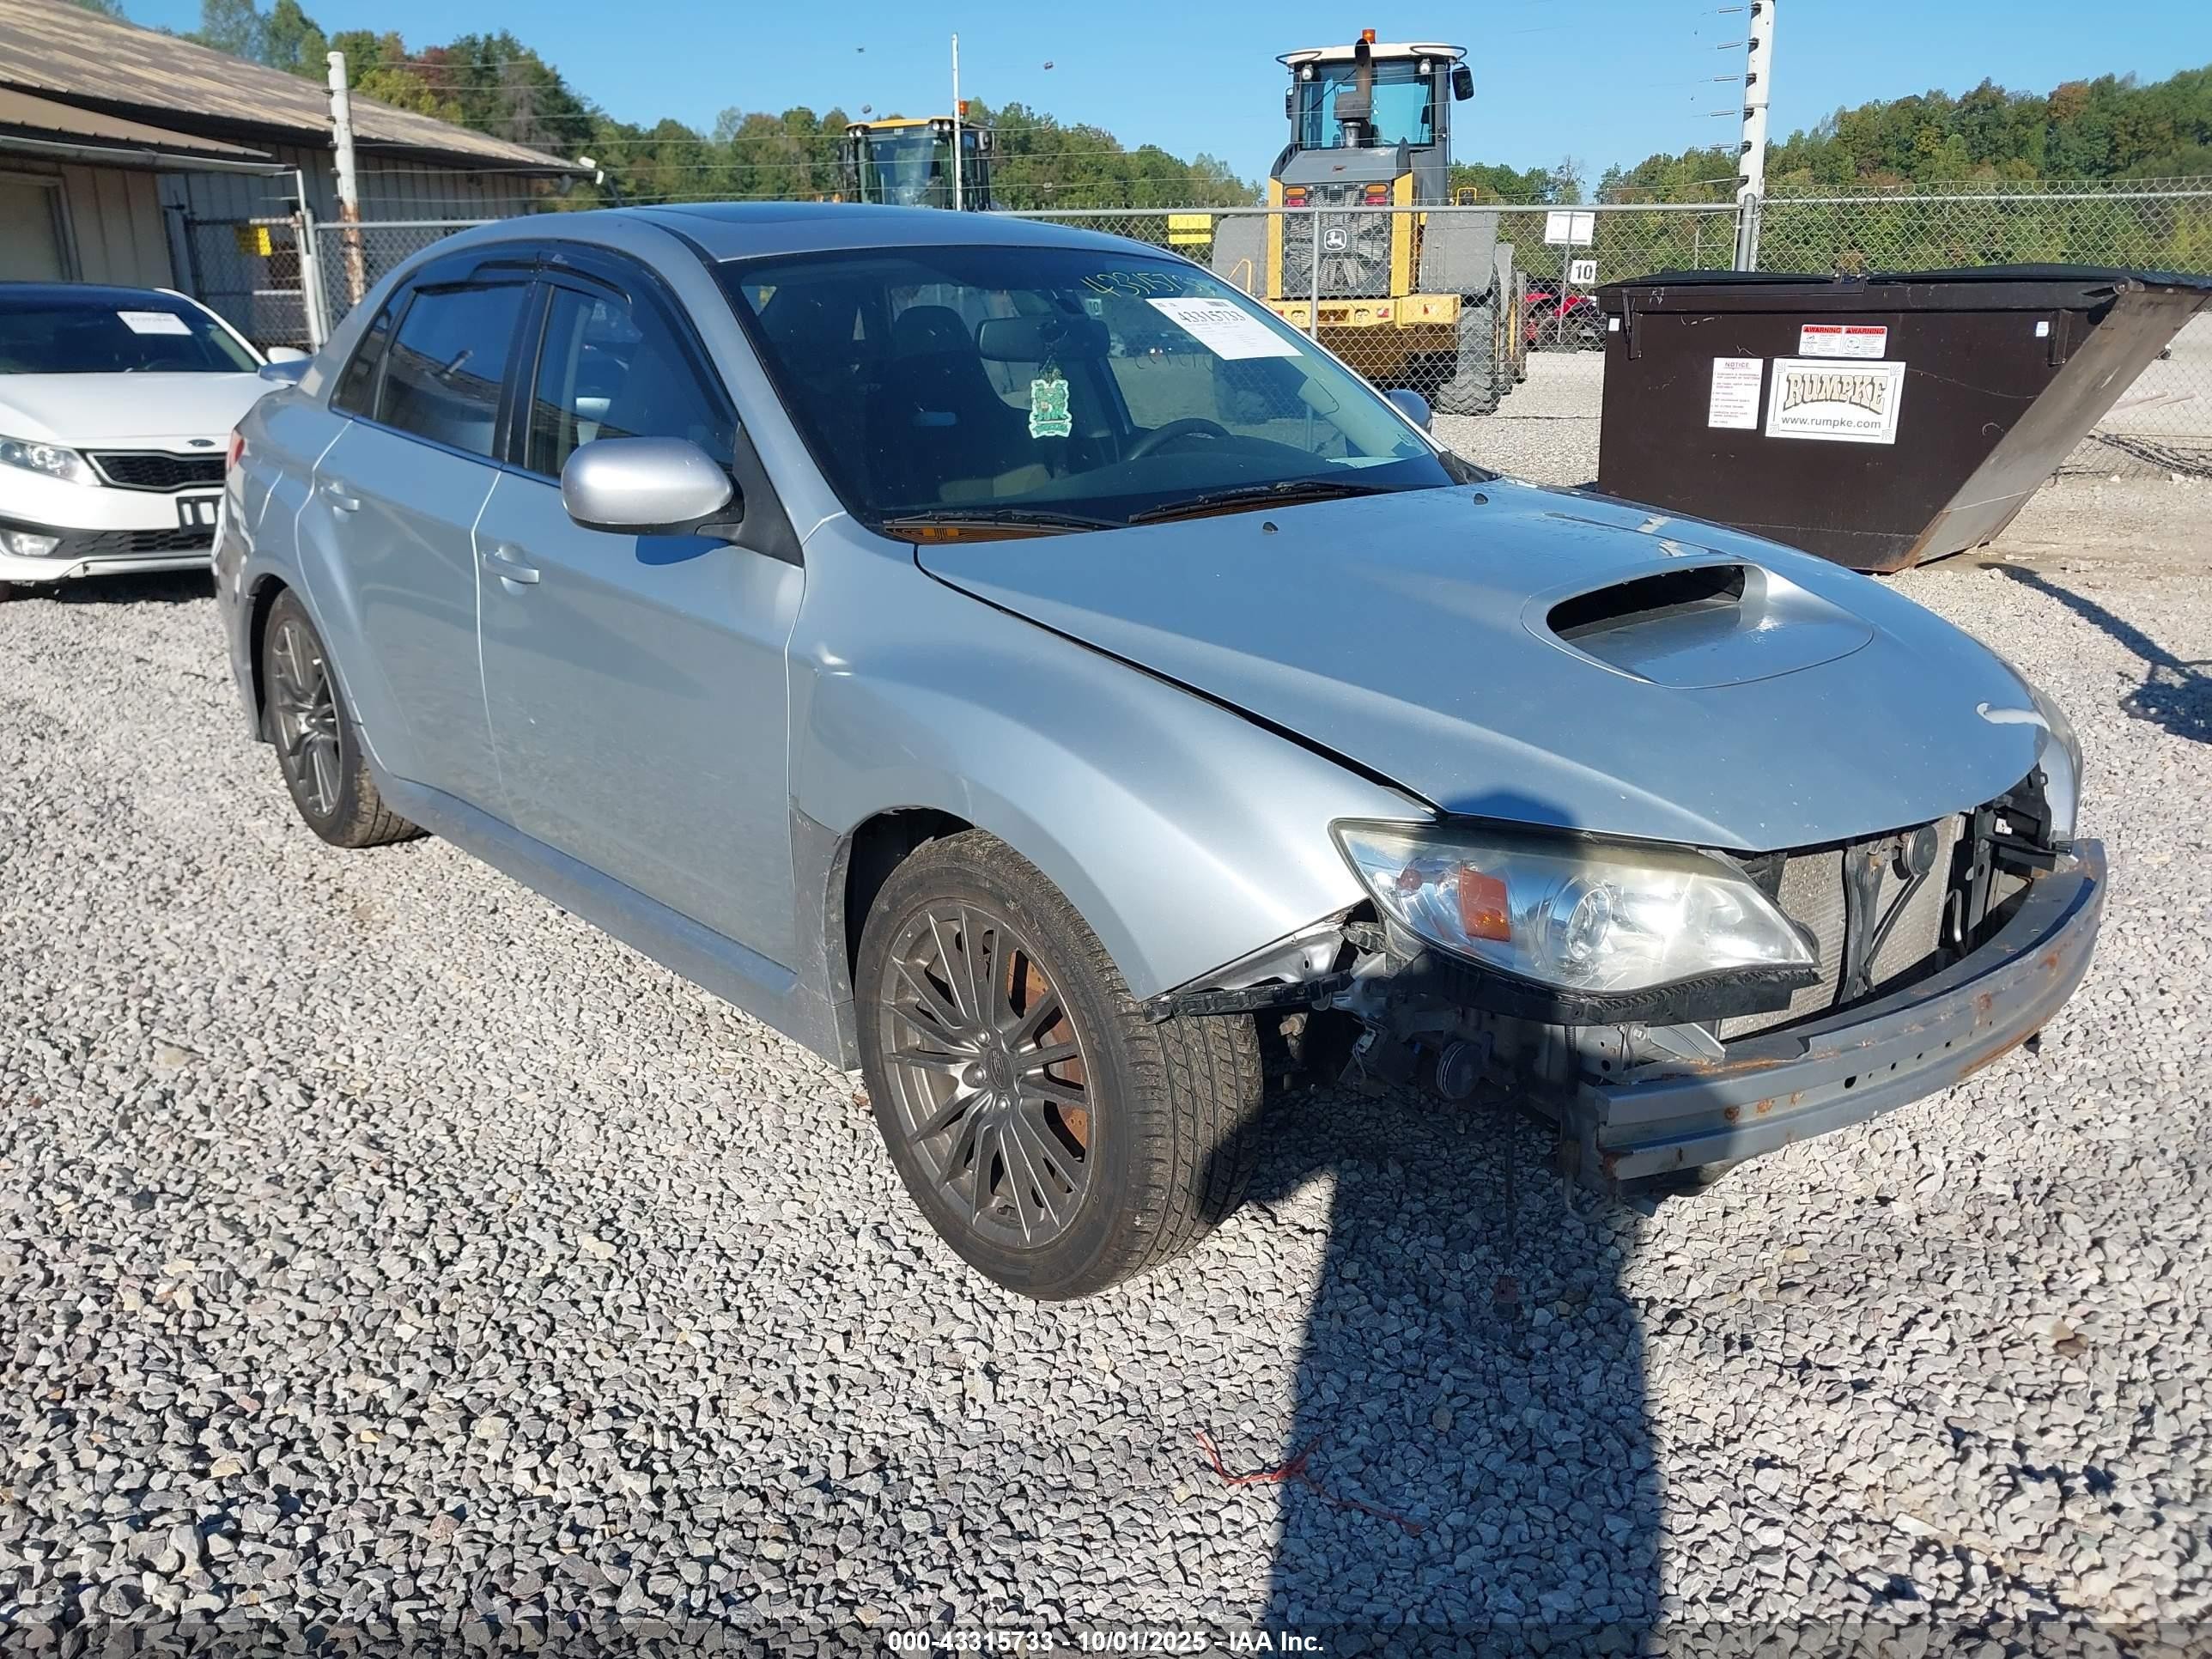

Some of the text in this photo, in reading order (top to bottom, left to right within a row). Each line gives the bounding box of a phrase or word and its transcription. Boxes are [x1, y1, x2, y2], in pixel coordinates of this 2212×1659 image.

[1576, 264, 1593, 280] 10
[1177, 310, 1247, 323] 43315733
[1783, 373, 1888, 415] RUMPKE
[1781, 416, 1881, 429] www.rumpke.com
